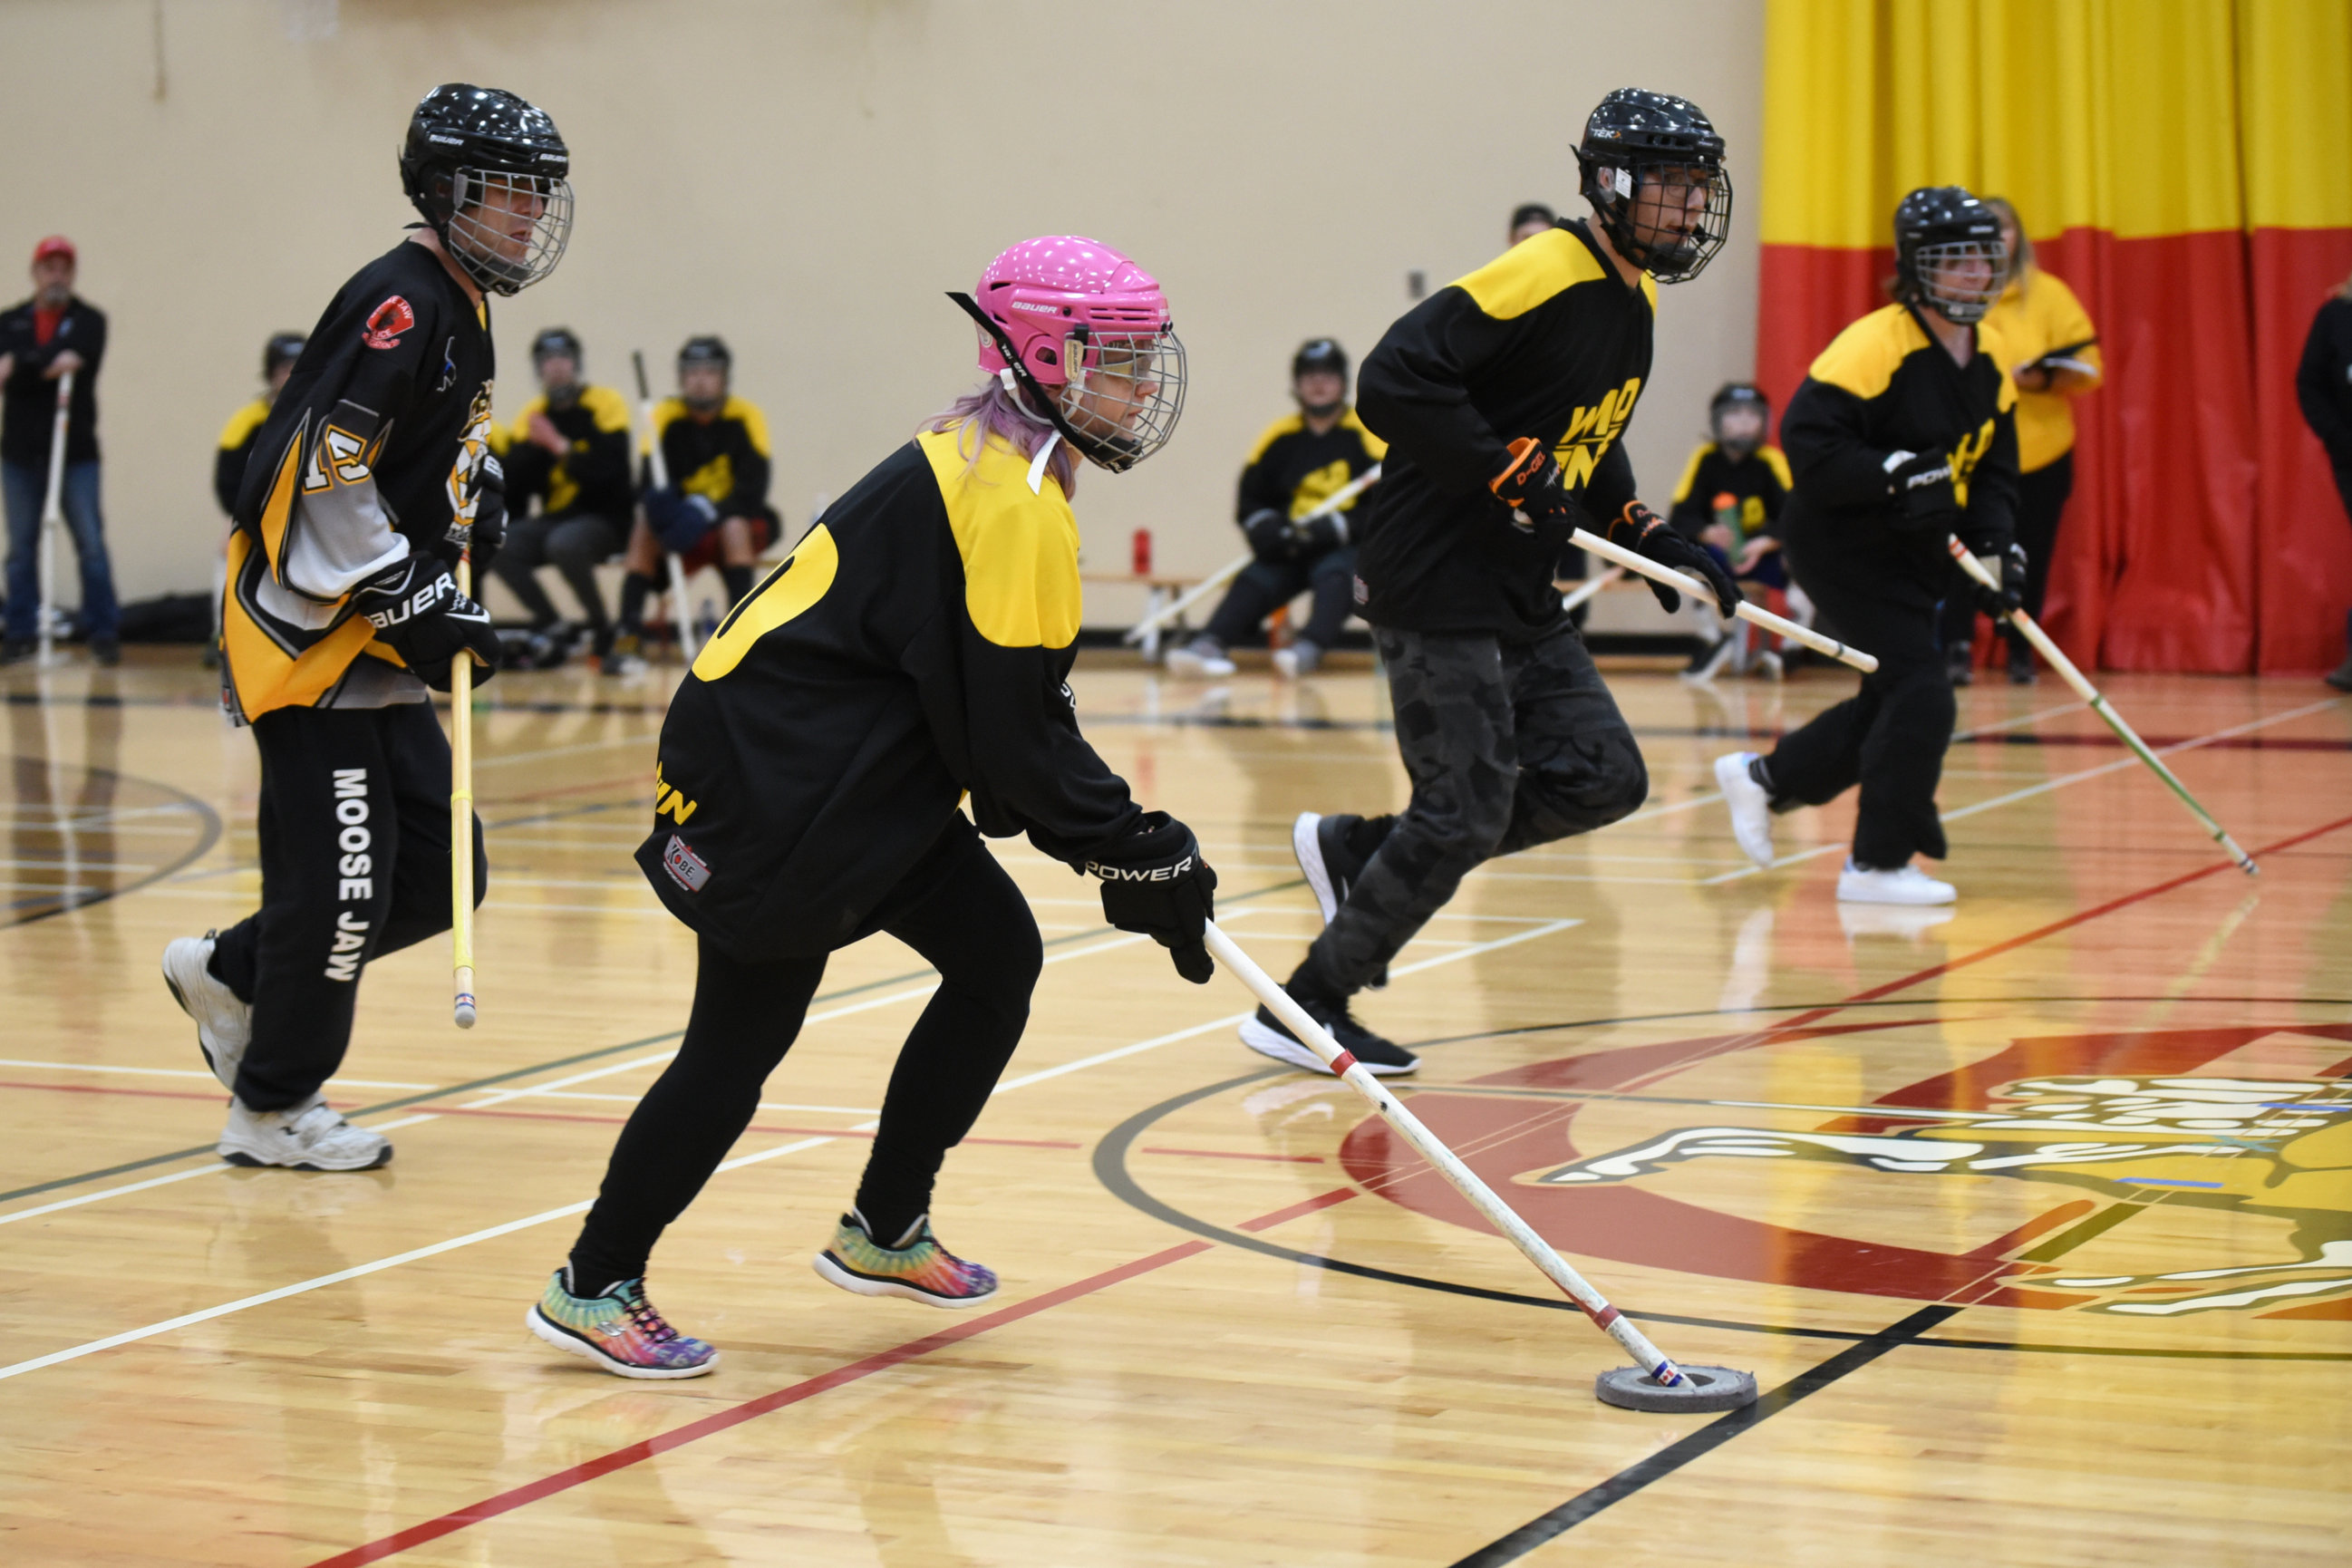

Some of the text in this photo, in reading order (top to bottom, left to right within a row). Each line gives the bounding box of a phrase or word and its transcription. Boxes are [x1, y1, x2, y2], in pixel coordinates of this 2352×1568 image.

[429, 134, 464, 146] BAUER
[1011, 301, 1058, 315] BAUER
[302, 423, 371, 495] 15
[364, 572, 457, 629] AUER
[324, 769, 373, 982] MOOSE JAW
